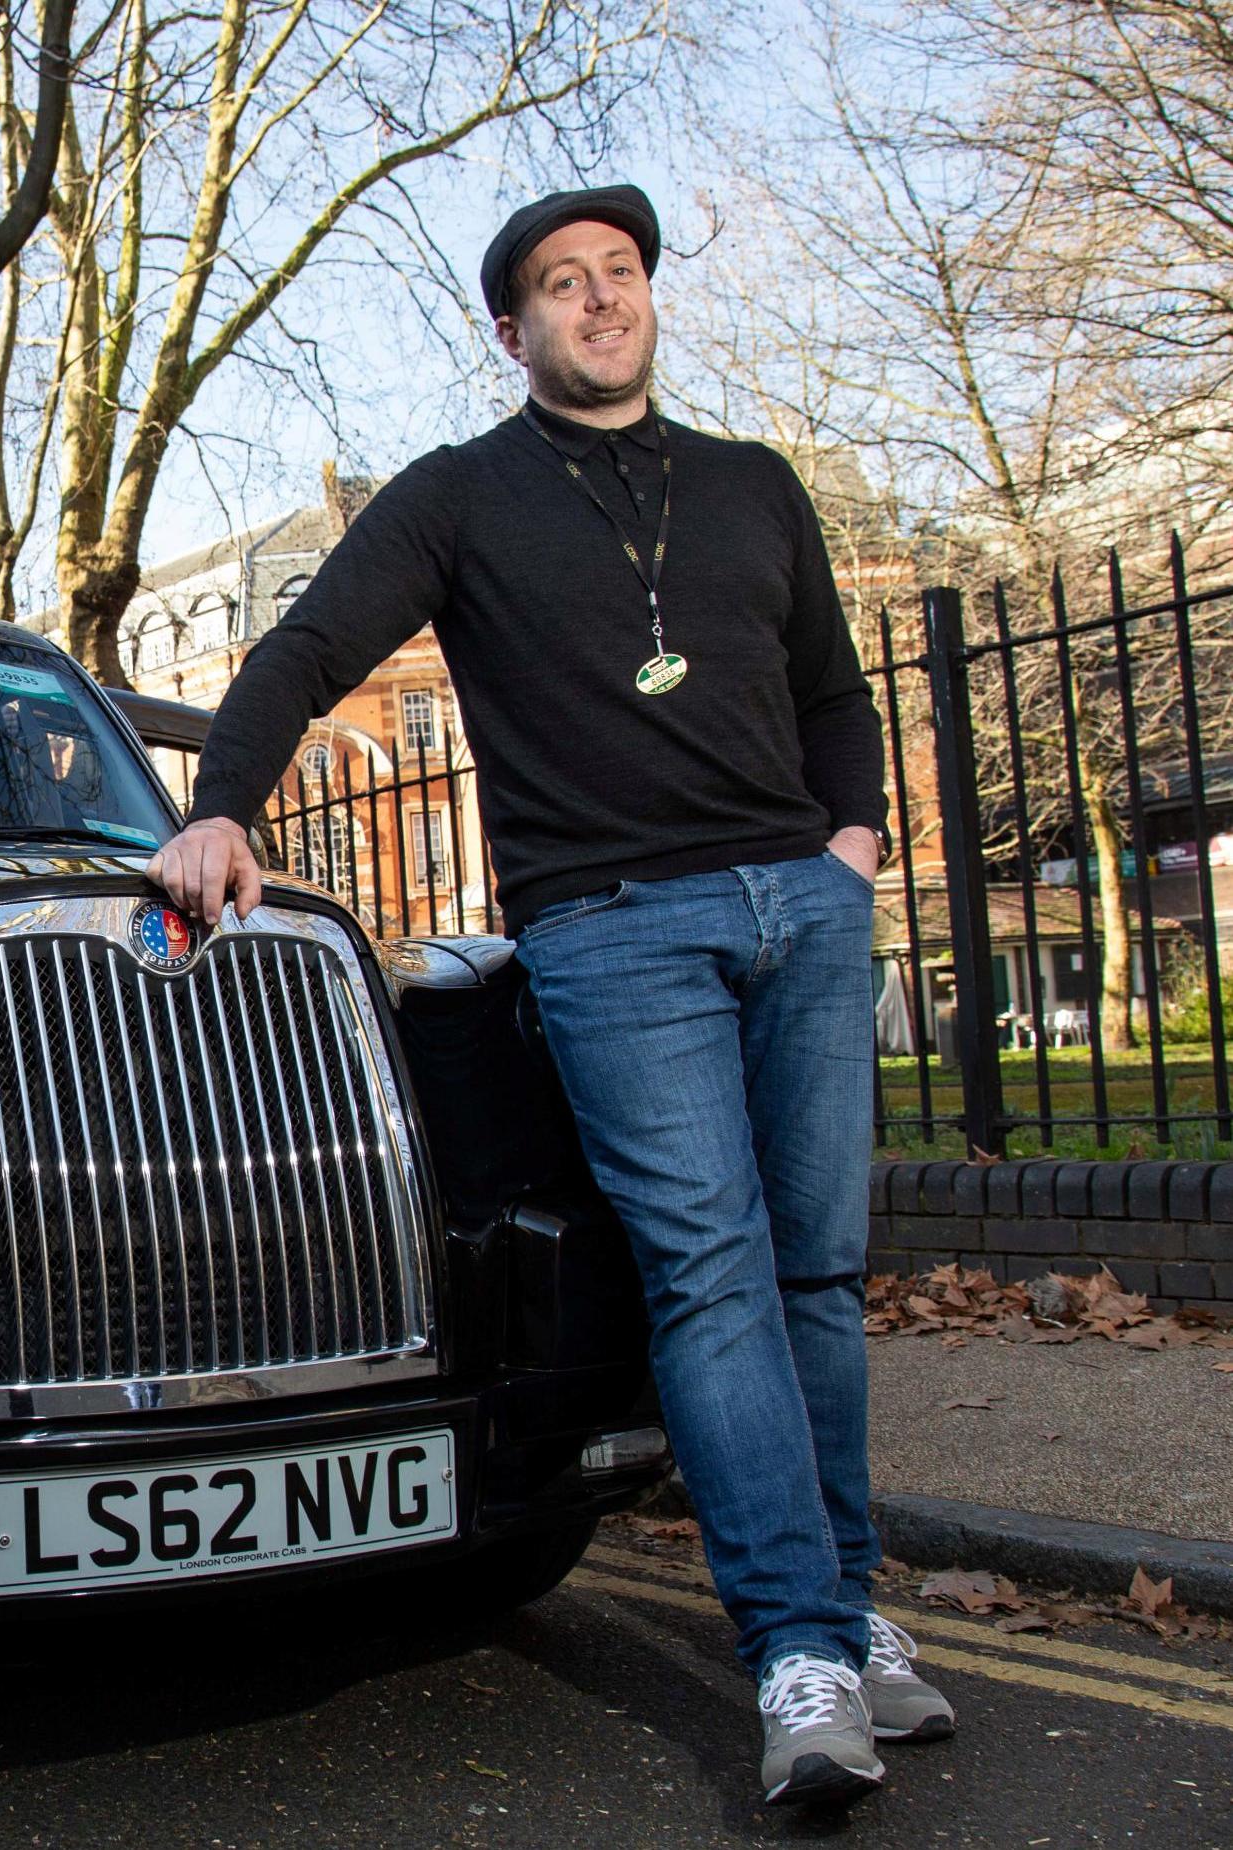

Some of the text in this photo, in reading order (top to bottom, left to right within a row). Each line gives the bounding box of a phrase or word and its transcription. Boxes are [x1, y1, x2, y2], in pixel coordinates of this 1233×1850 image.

[622, 542, 639, 562] LCDC
[654, 542, 665, 561] LCDC
[133, 917, 142, 936] THE
[143, 950, 192, 967] COMPANY
[24, 1446, 428, 1575] LS62 NVG
